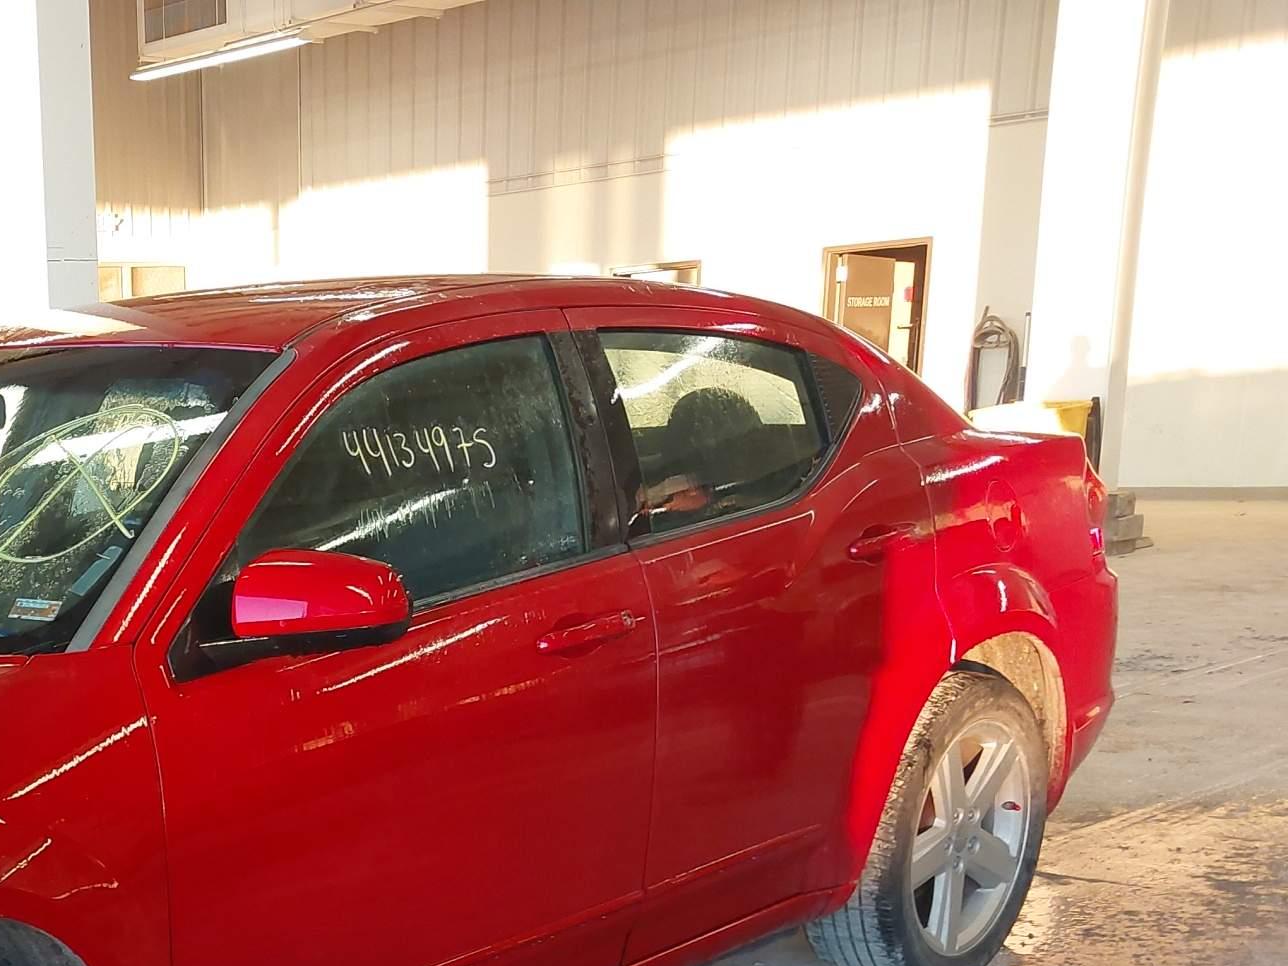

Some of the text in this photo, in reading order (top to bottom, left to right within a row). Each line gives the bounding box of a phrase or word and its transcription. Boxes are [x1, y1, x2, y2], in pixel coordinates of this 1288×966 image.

[847, 296, 890, 307] STORAGE ROOM
[343, 426, 497, 477] 44134975
